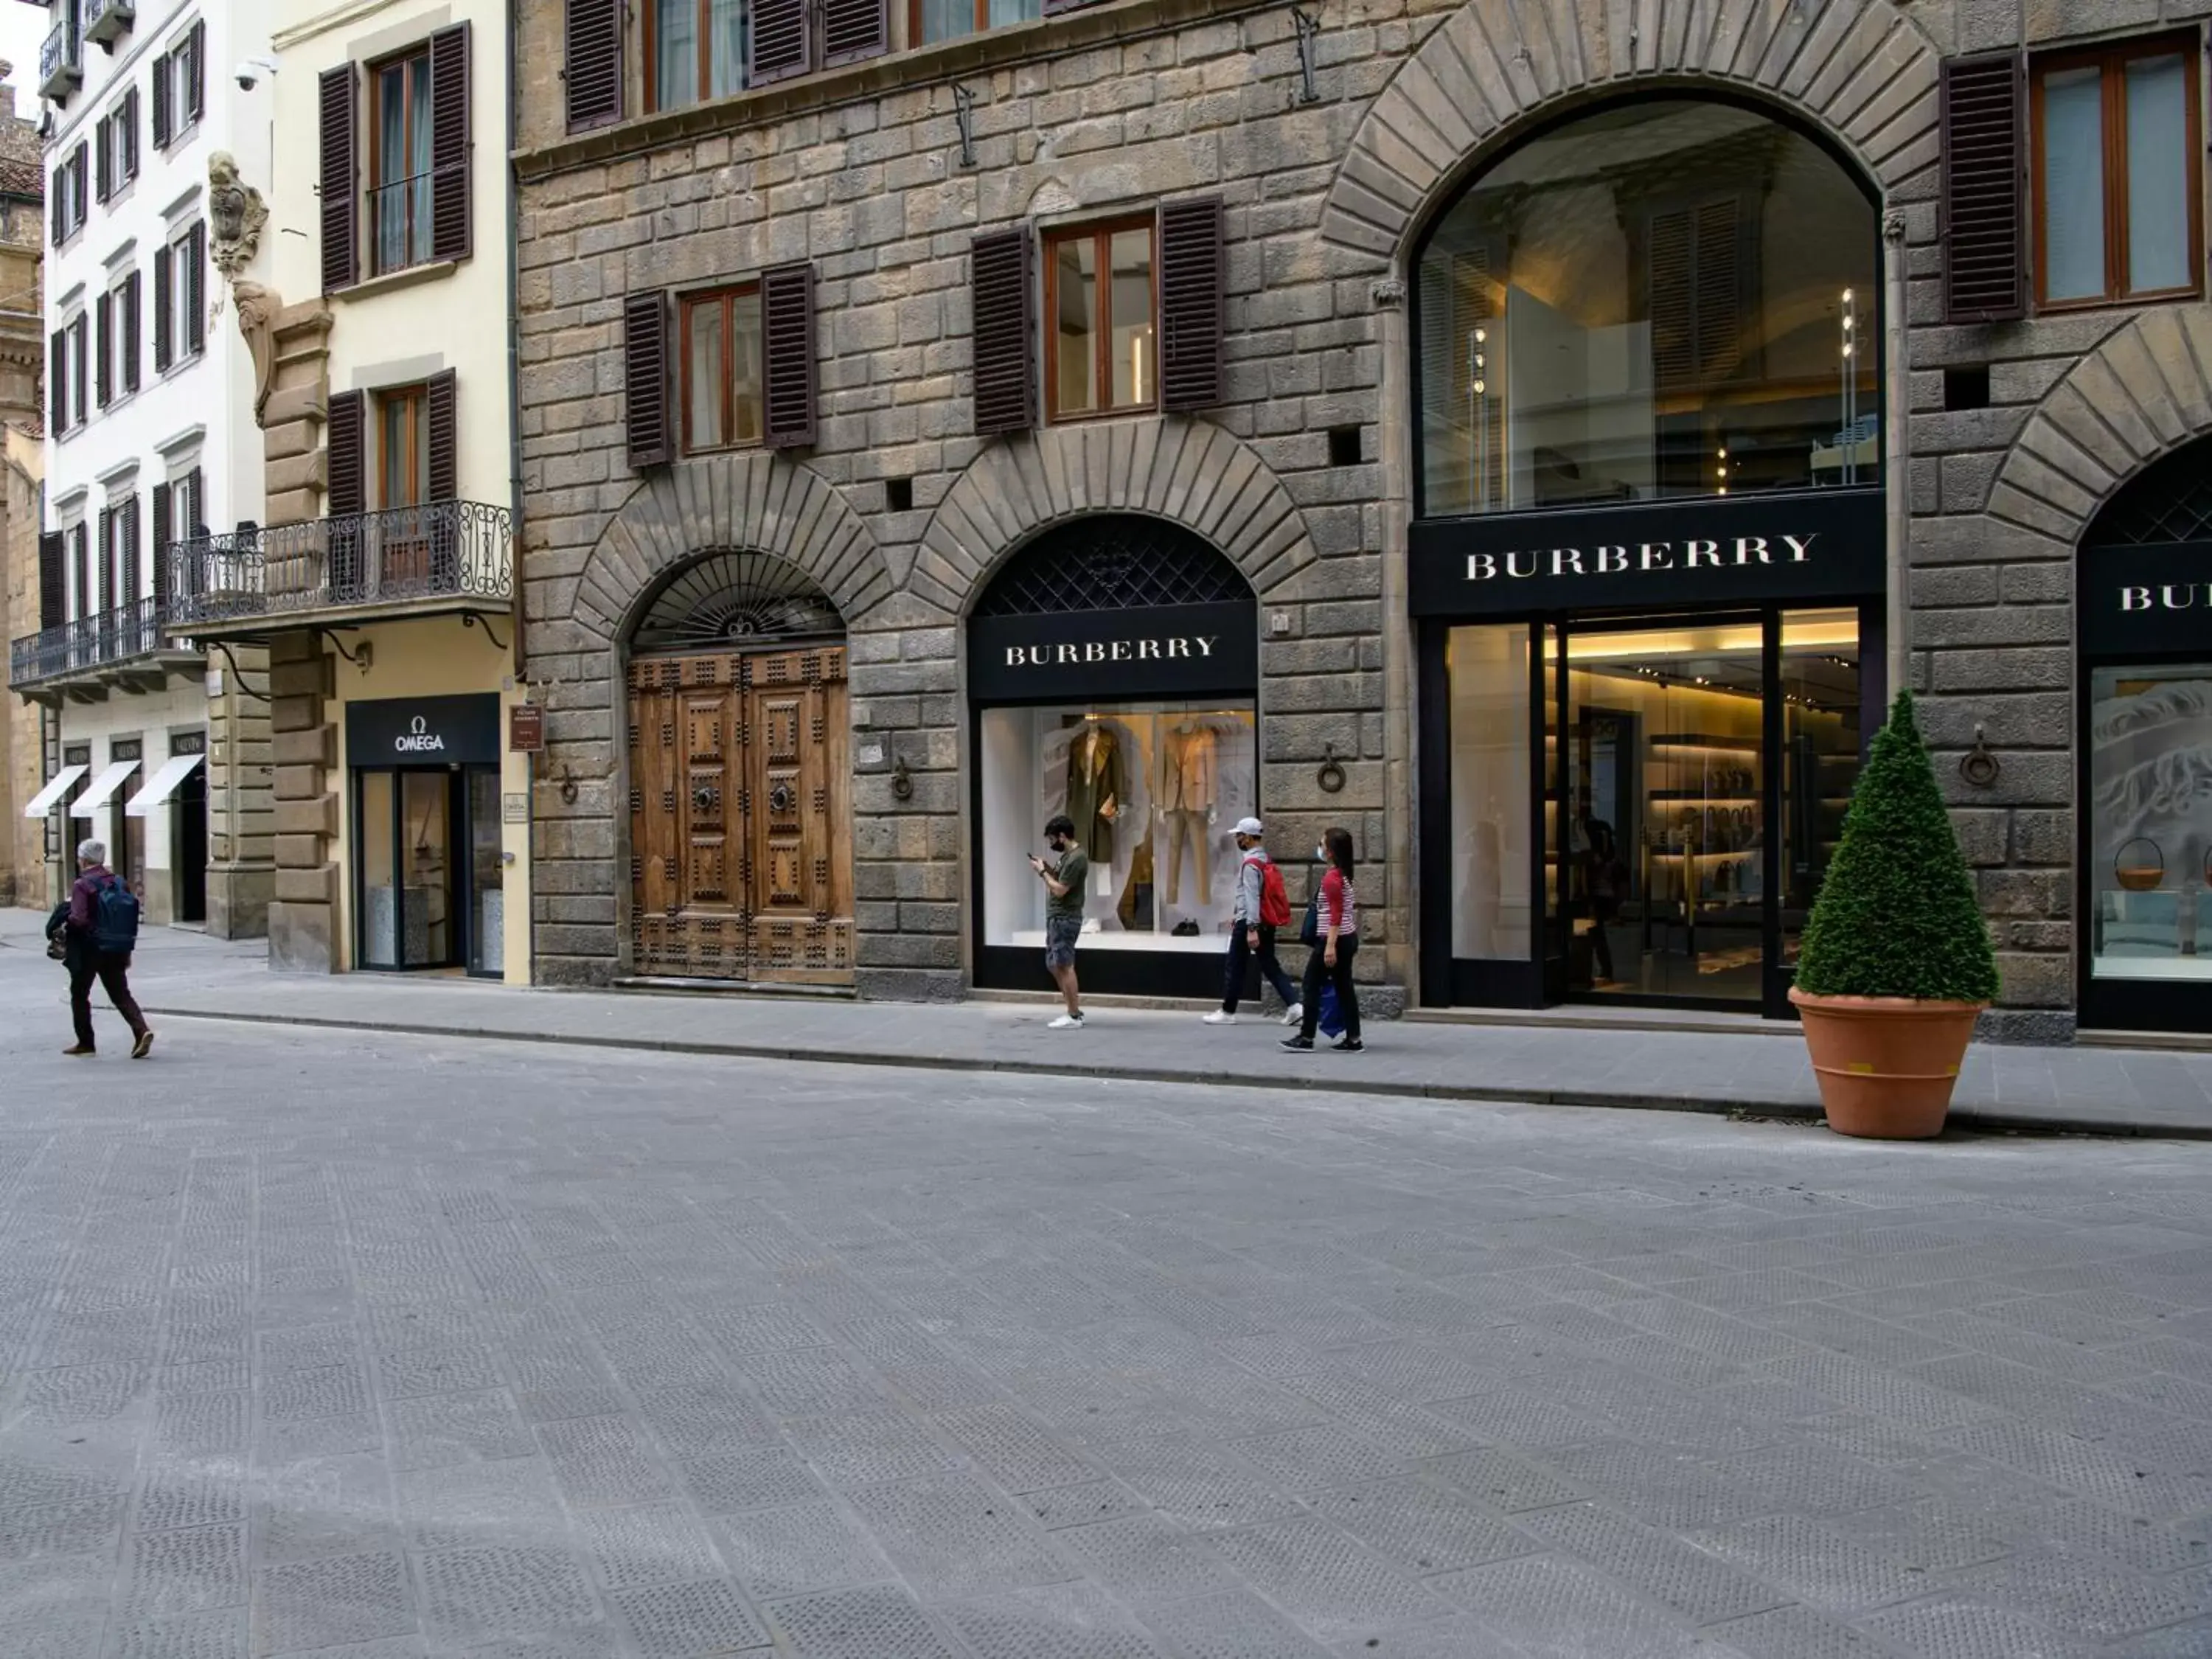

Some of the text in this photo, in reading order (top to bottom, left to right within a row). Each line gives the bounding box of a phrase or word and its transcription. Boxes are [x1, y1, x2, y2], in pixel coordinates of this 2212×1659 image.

[1462, 532, 1820, 580] BURBERRY
[2117, 582, 2212, 611] BU
[1005, 636, 1219, 666] BURBERRY
[394, 734, 445, 751] OMEGA
